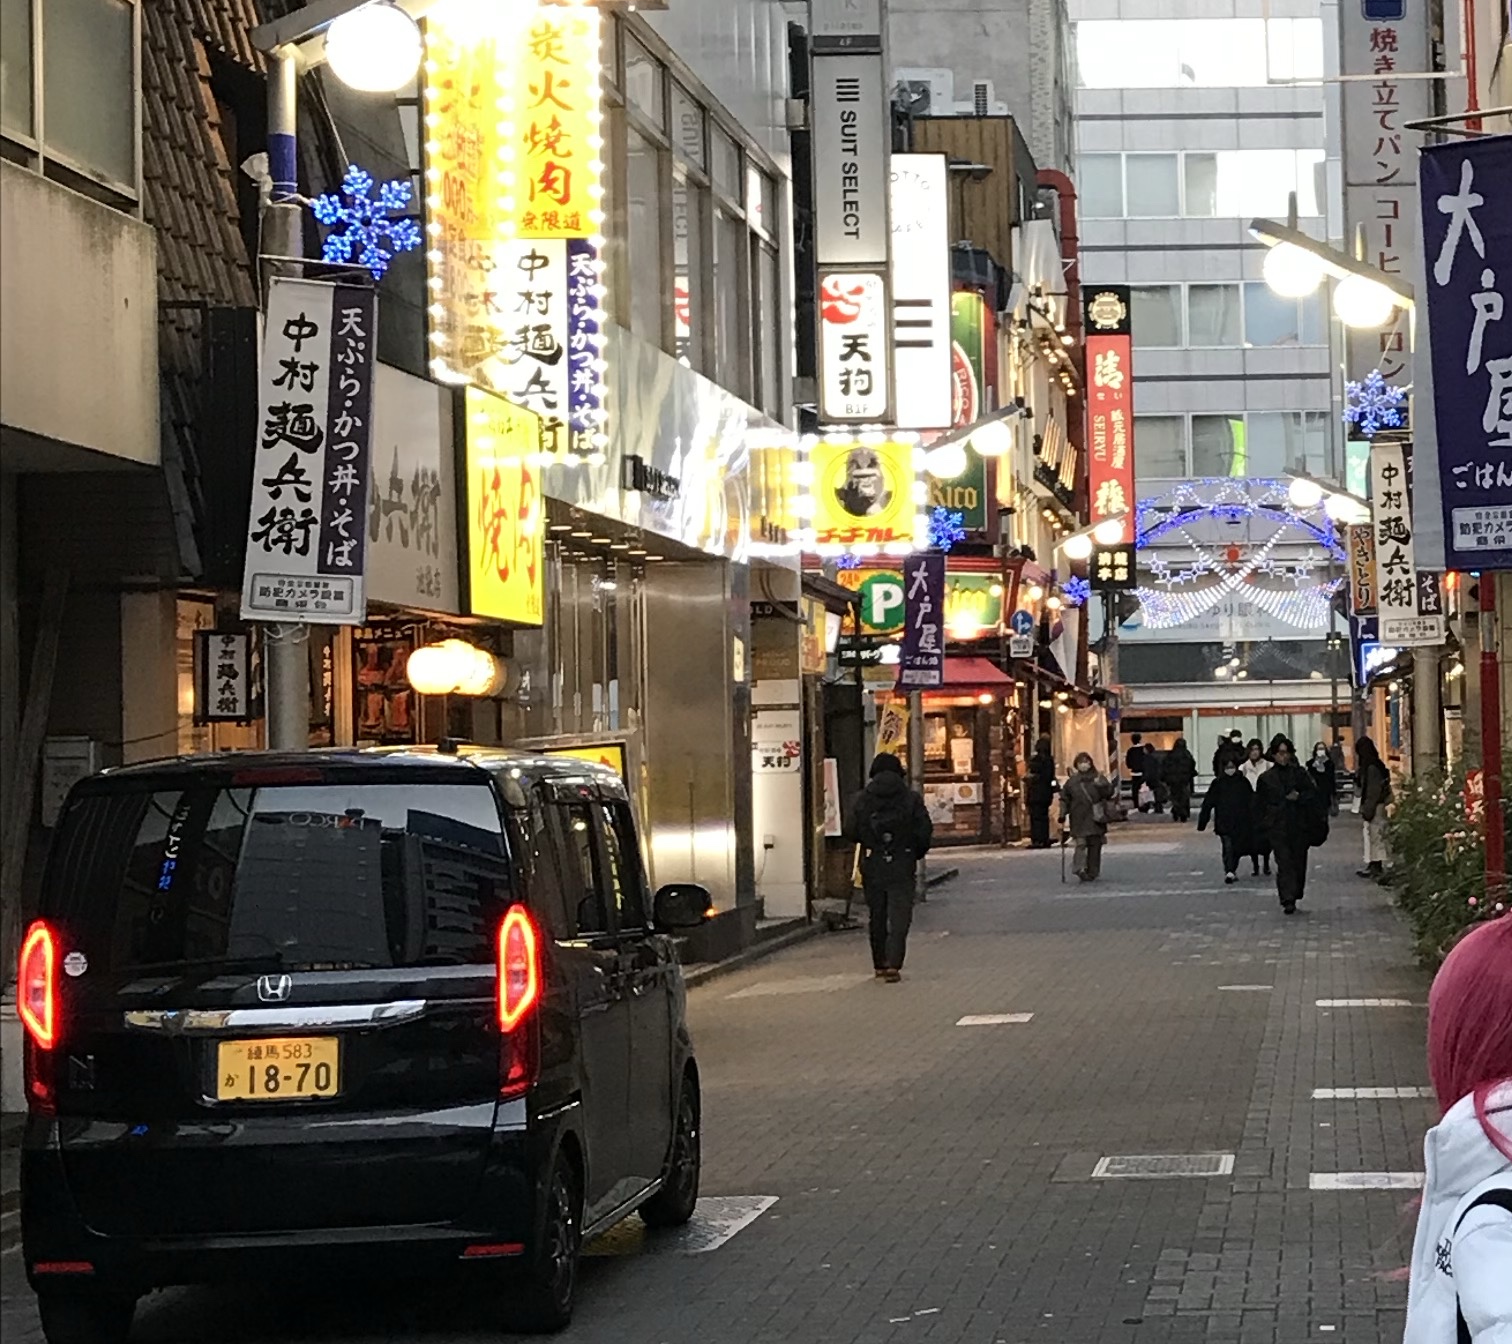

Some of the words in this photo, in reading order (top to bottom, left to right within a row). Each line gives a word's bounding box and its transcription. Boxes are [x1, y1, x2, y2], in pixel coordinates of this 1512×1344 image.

[521, 22, 576, 207] 炭火焼肉
[839, 109, 858, 156] SUIT
[1369, 26, 1402, 184] 焼き立てパン
[840, 160, 860, 241] SELECT
[1376, 199, 1406, 380] コーヒロン
[251, 311, 325, 556] 中村麺兵衛
[324, 307, 367, 569] 天ぷら・かつ丼・そば
[1093, 414, 1106, 463] SEIRYU
[1353, 527, 1371, 610] やきとり
[1377, 461, 1416, 608] 中村麺兵衛
[871, 582, 904, 624] P
[907, 560, 942, 655] 大戸屋
[248, 1061, 331, 1095] 18-70
[282, 1043, 312, 1060] 583
